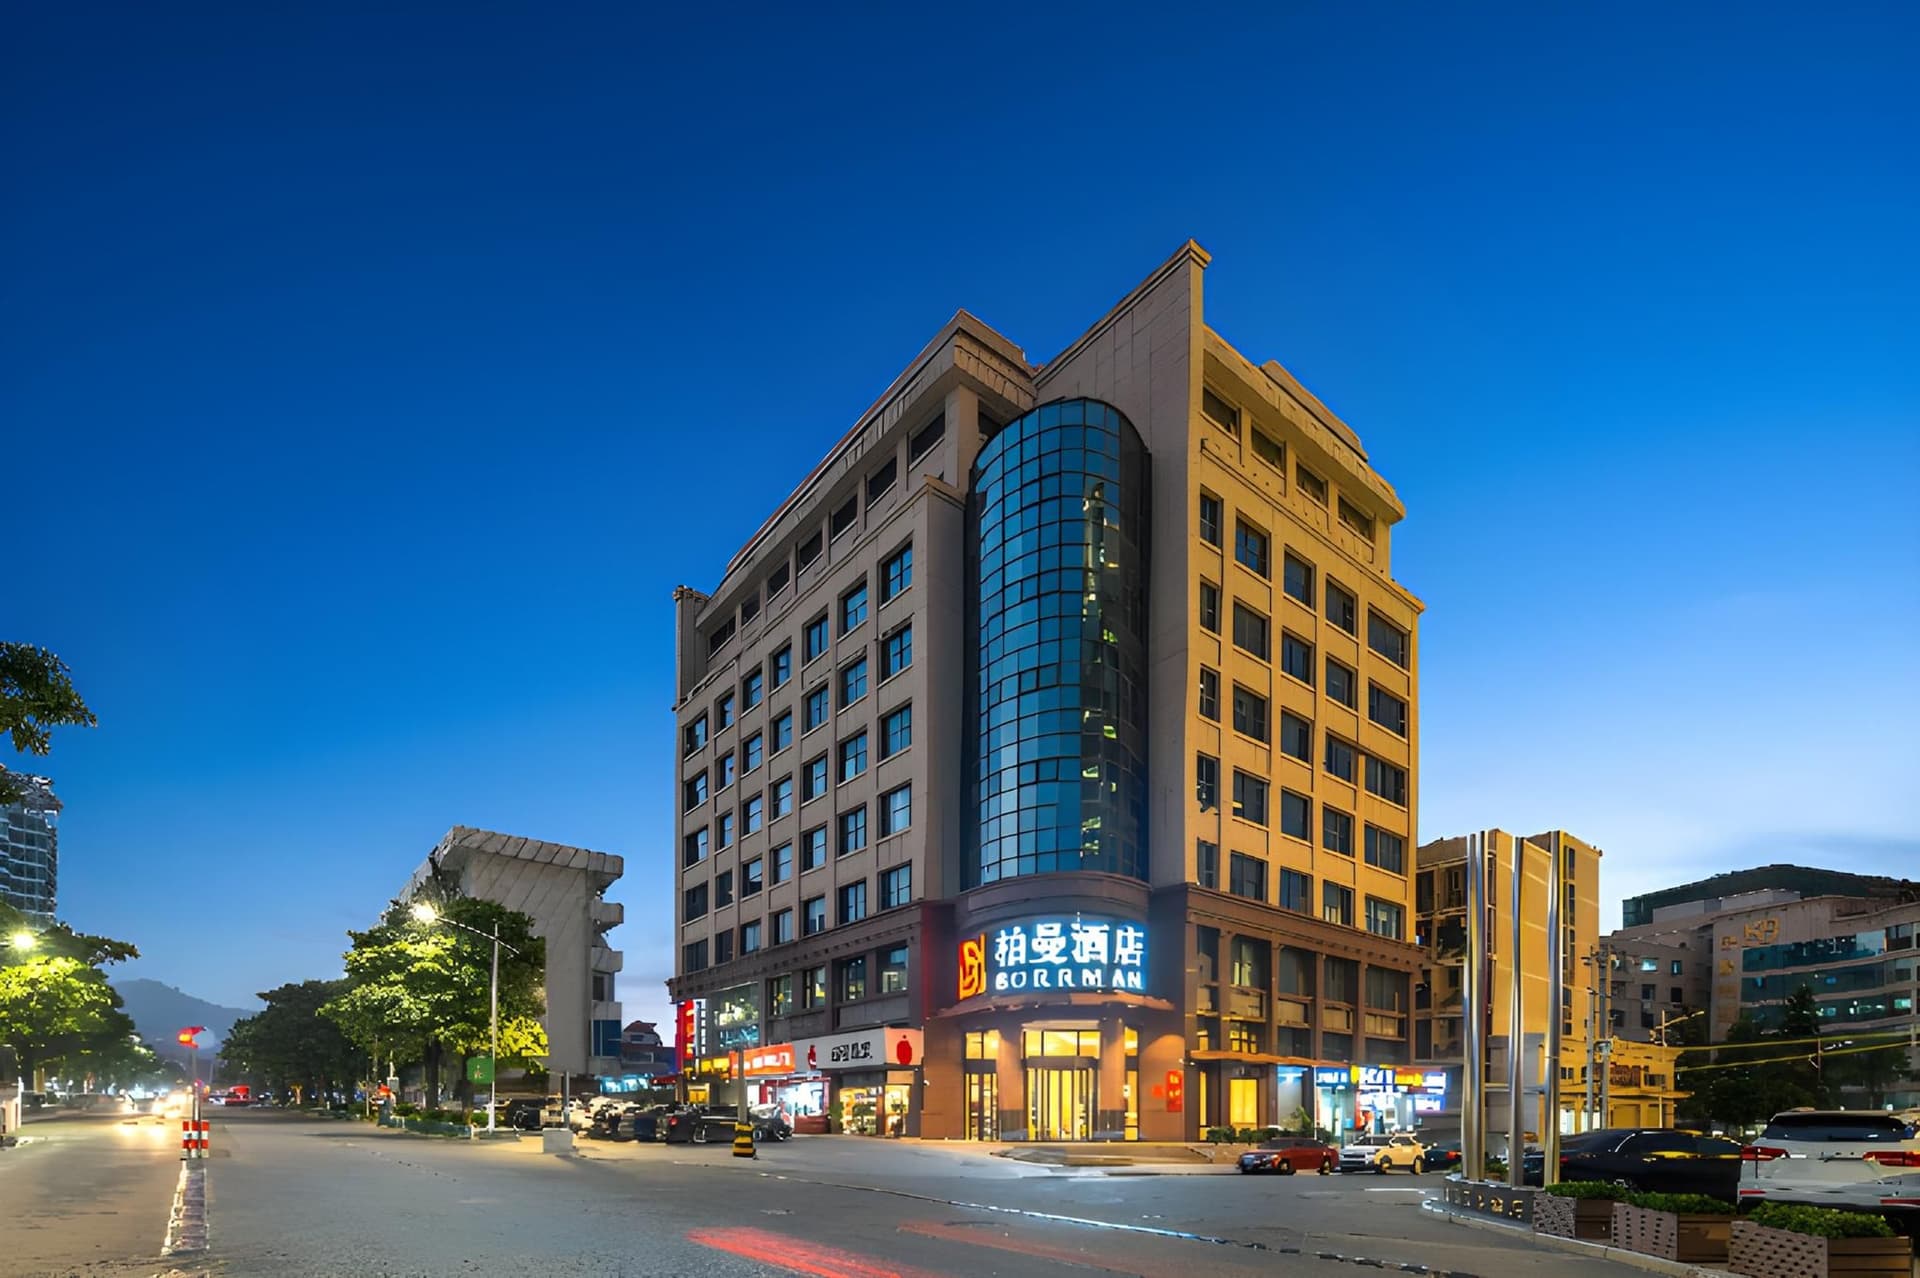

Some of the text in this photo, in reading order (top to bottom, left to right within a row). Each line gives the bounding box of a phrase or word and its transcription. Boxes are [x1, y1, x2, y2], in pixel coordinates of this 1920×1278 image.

[994, 922, 1144, 967] 柏曼酒店
[994, 968, 1144, 990] BORRMAN
